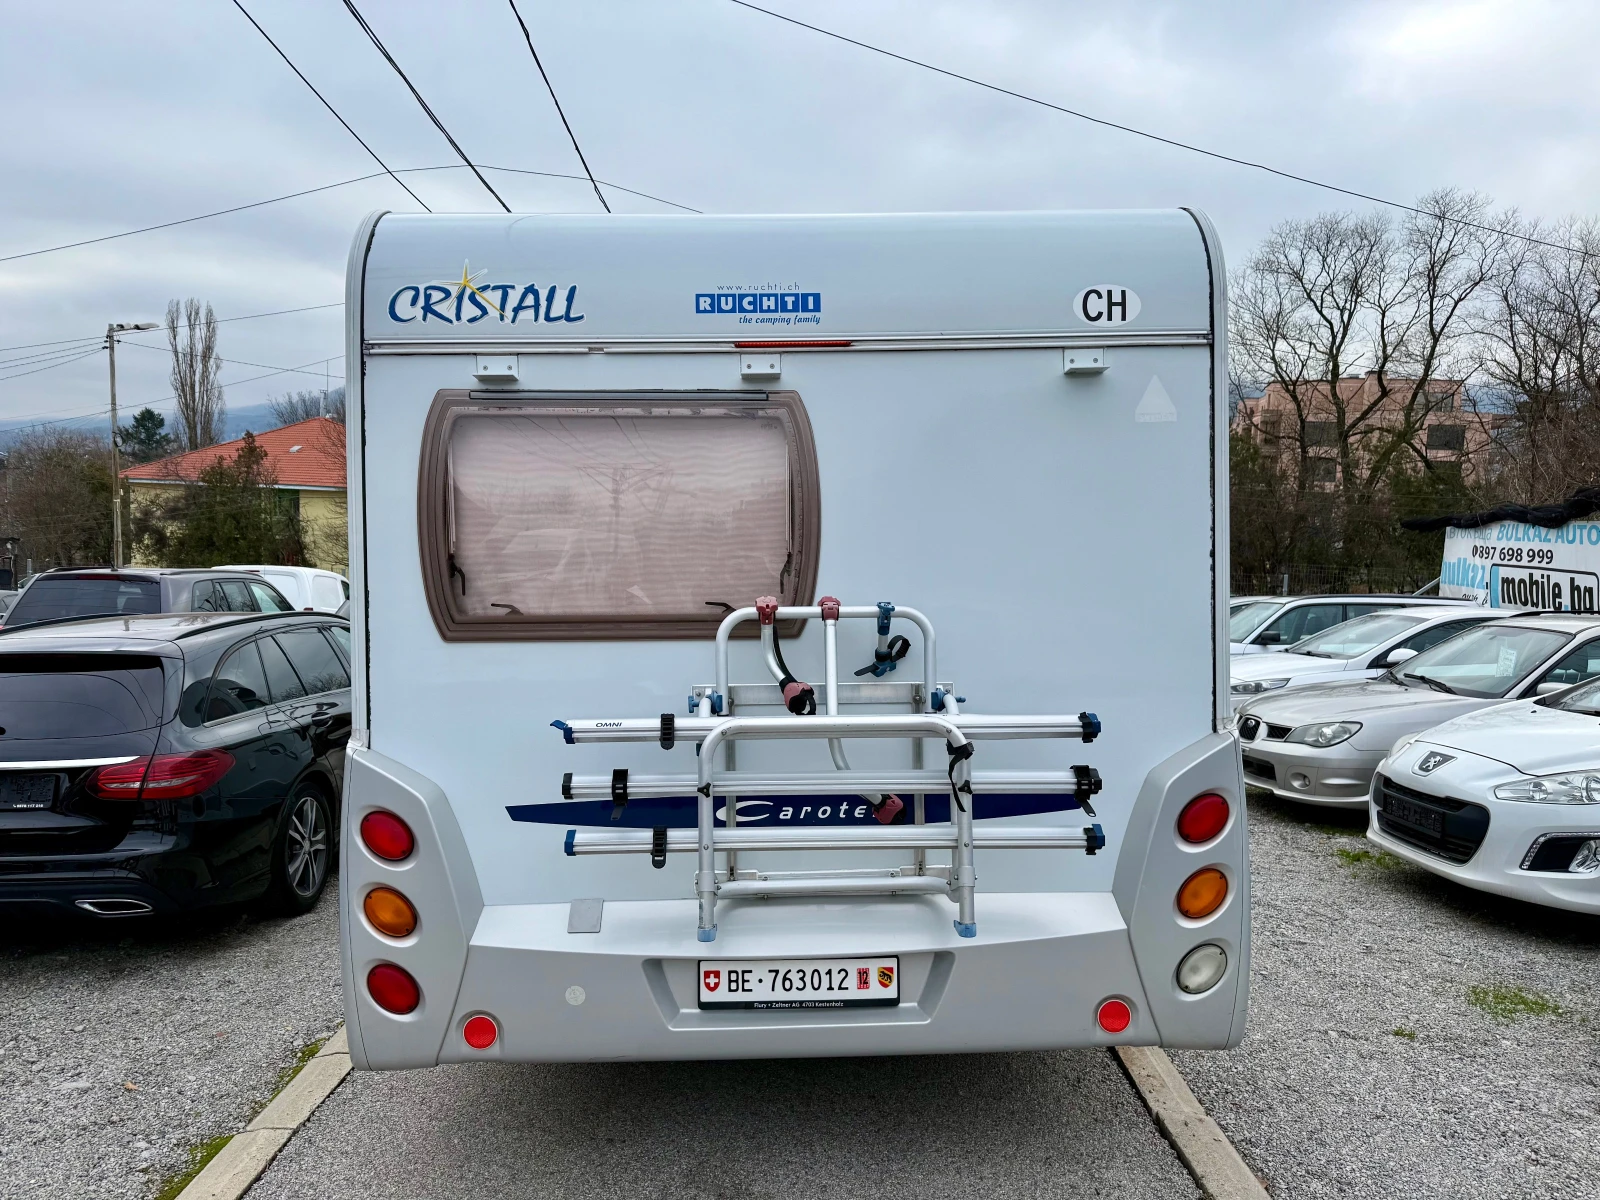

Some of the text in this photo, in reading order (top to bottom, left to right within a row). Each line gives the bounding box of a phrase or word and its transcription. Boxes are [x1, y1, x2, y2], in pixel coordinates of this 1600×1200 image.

[717, 282, 800, 291] www.ruchti.ch
[388, 283, 586, 325] CRISTALL
[697, 294, 818, 312] RUCHTI
[1082, 289, 1127, 322] CH
[739, 315, 821, 326] the camping family
[1496, 523, 1552, 543] BULKAZ
[1554, 524, 1600, 546] AUTO
[1472, 545, 1554, 565] 0897 698 999
[715, 801, 876, 822] Carote
